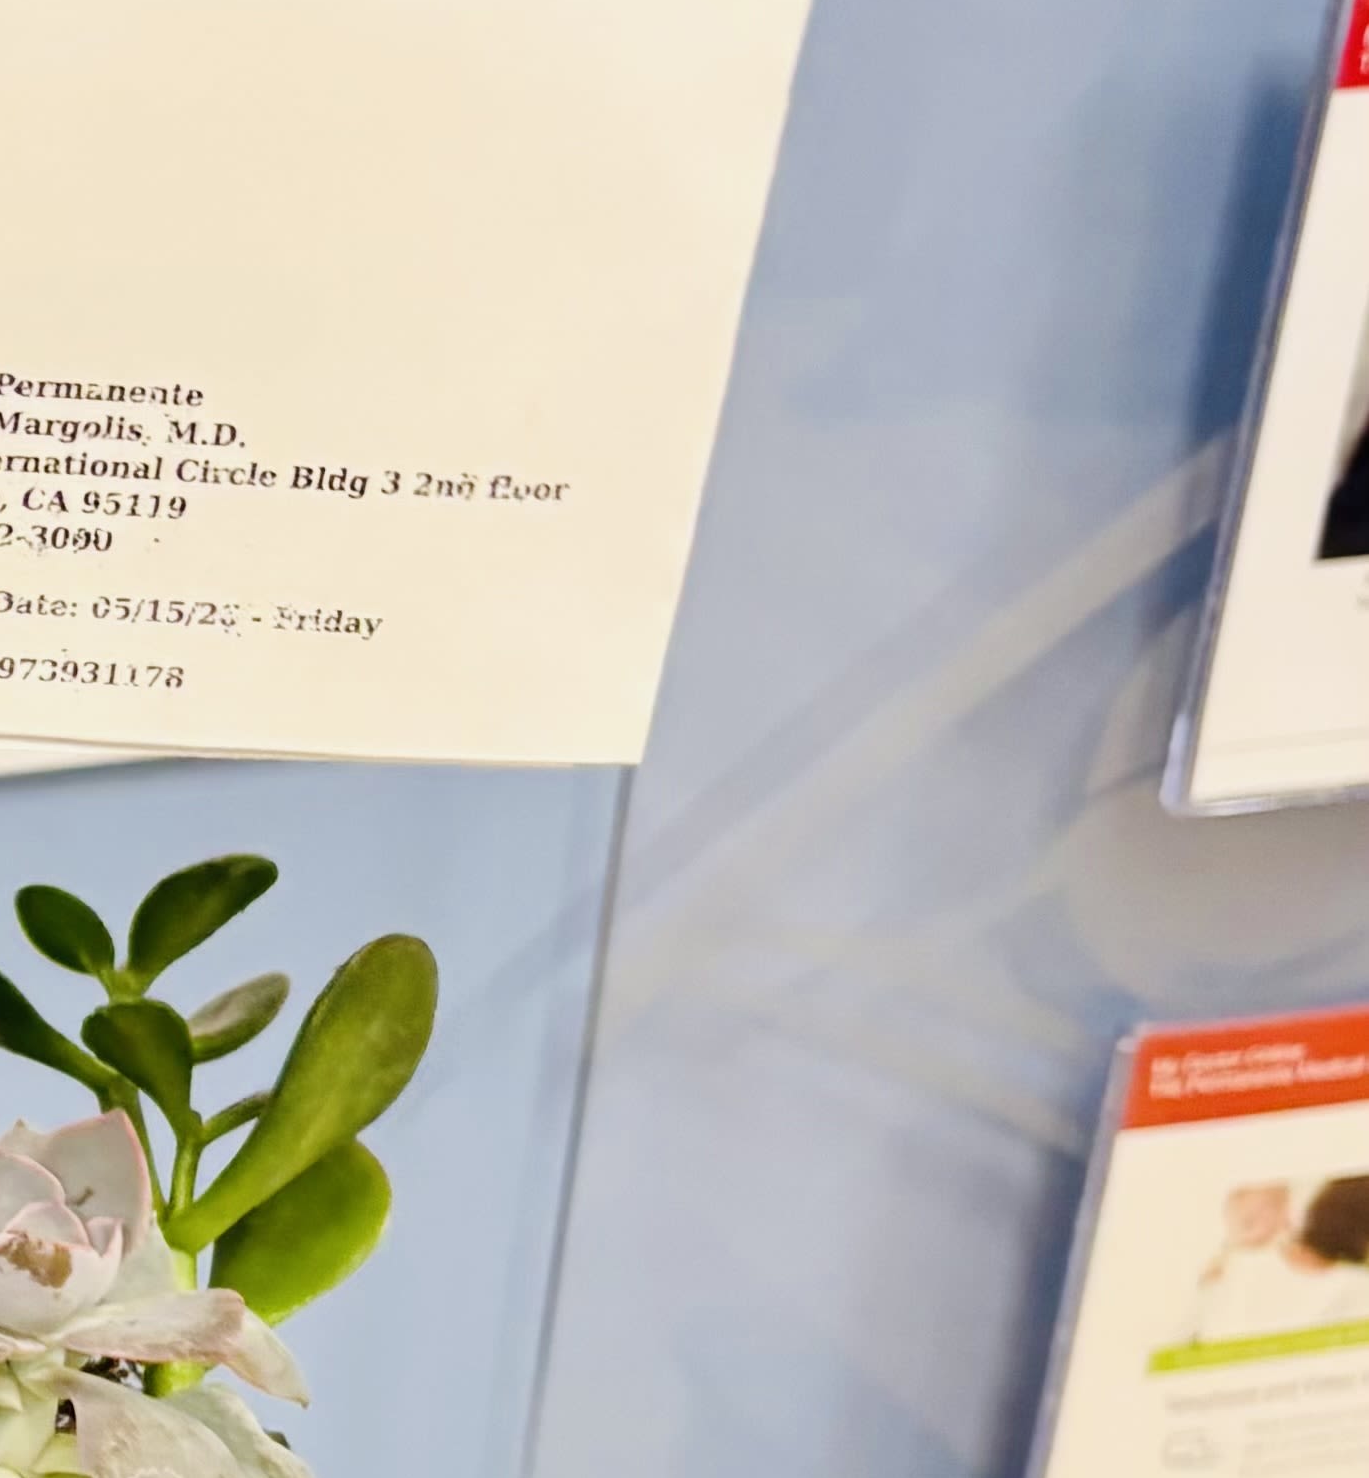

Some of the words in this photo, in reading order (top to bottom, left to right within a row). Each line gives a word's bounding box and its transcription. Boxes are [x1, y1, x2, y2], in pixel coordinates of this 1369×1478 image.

[165, 418, 247, 449] M.D.
[175, 458, 278, 487] Circle
[290, 465, 369, 500] Bldg
[380, 470, 402, 496] 3
[22, 487, 70, 513] CA
[273, 605, 383, 640] Friday
